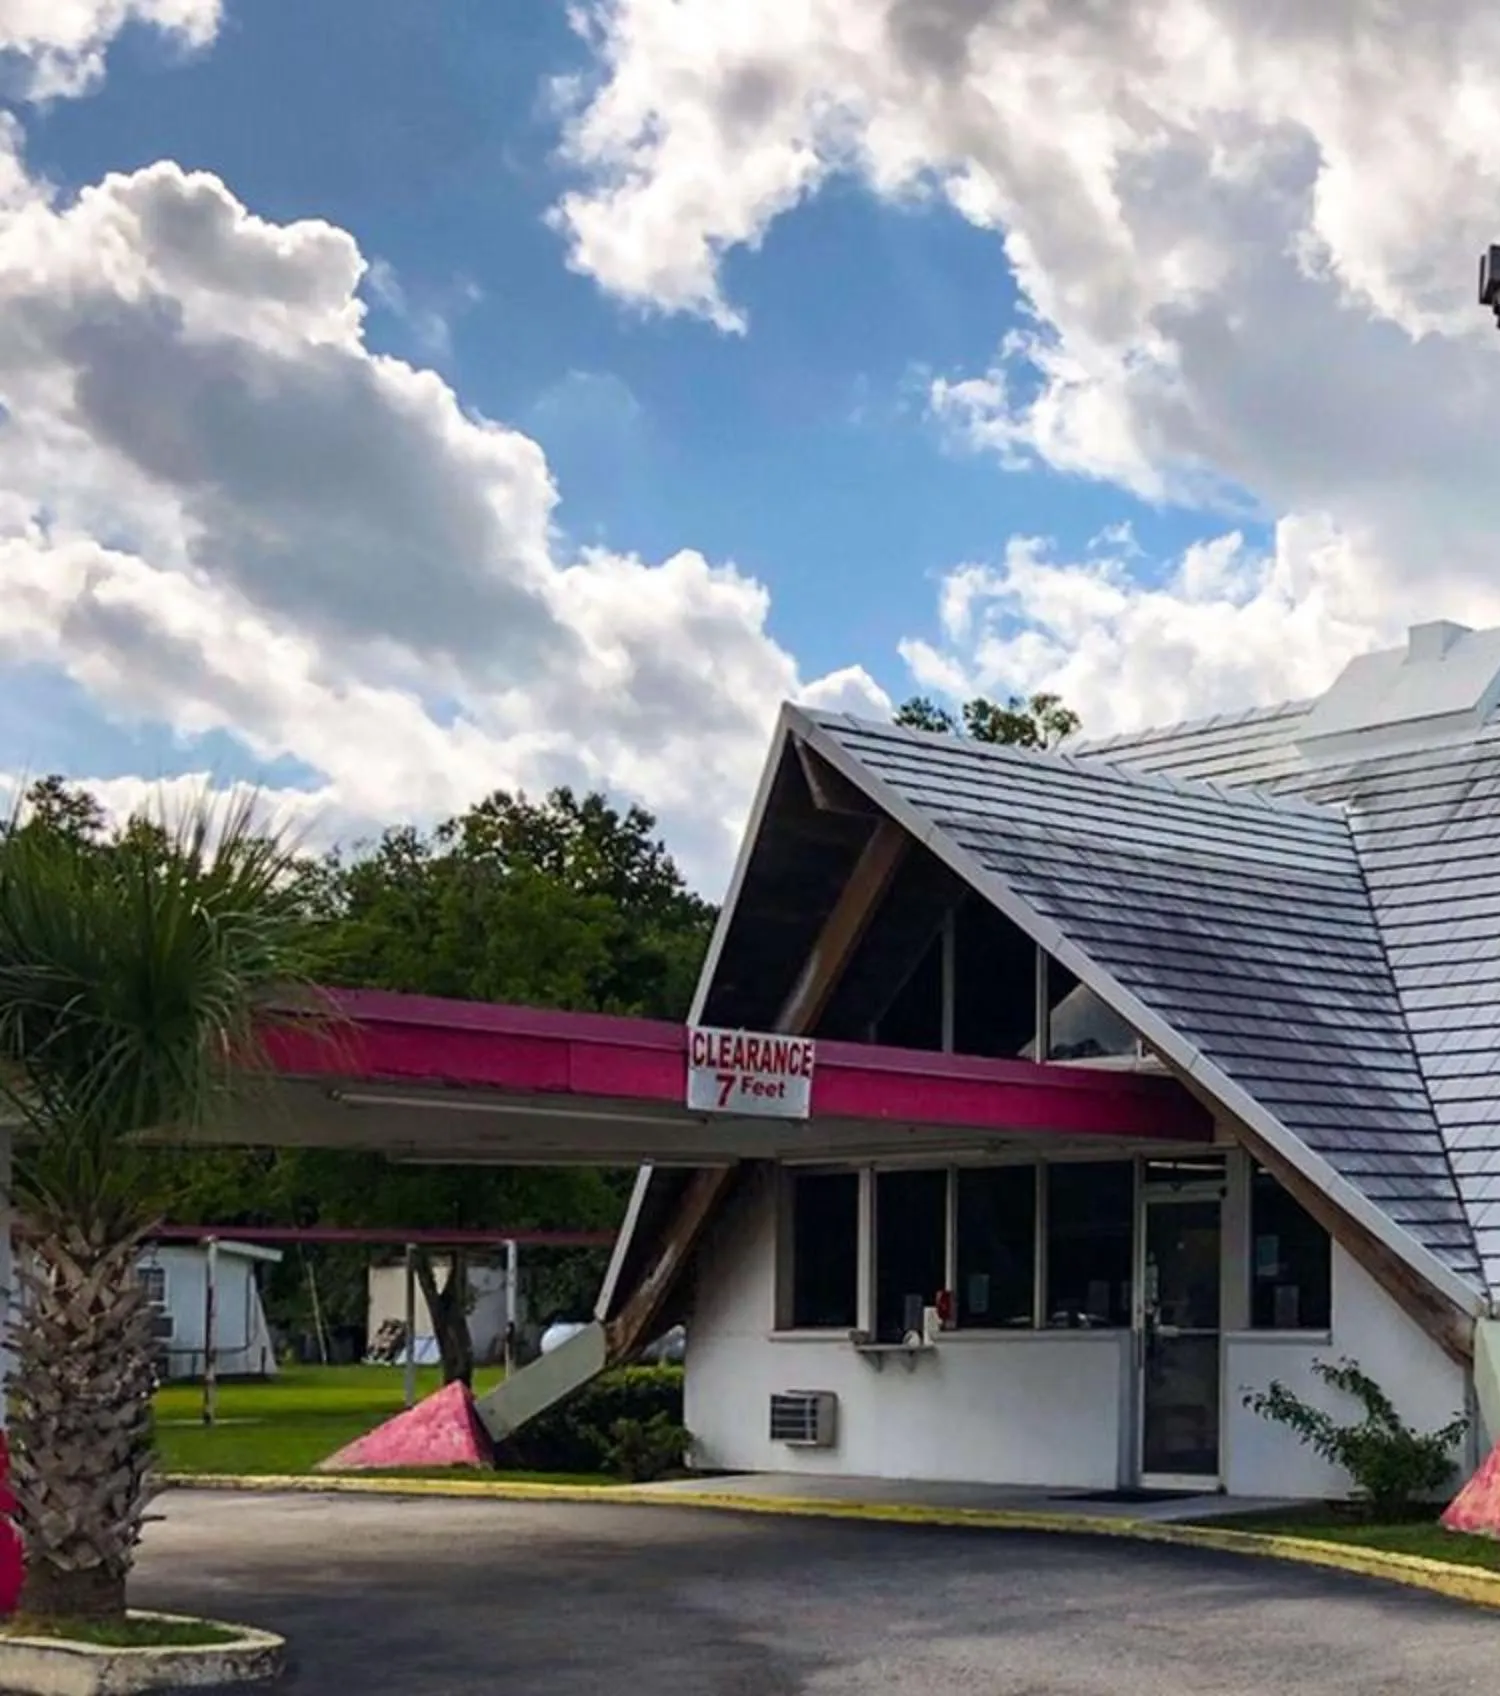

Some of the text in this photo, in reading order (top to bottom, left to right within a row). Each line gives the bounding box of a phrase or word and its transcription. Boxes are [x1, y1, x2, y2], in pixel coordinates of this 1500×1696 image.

[692, 1032, 812, 1077] CLEARANCE
[716, 1073, 785, 1107] 7 Feet
